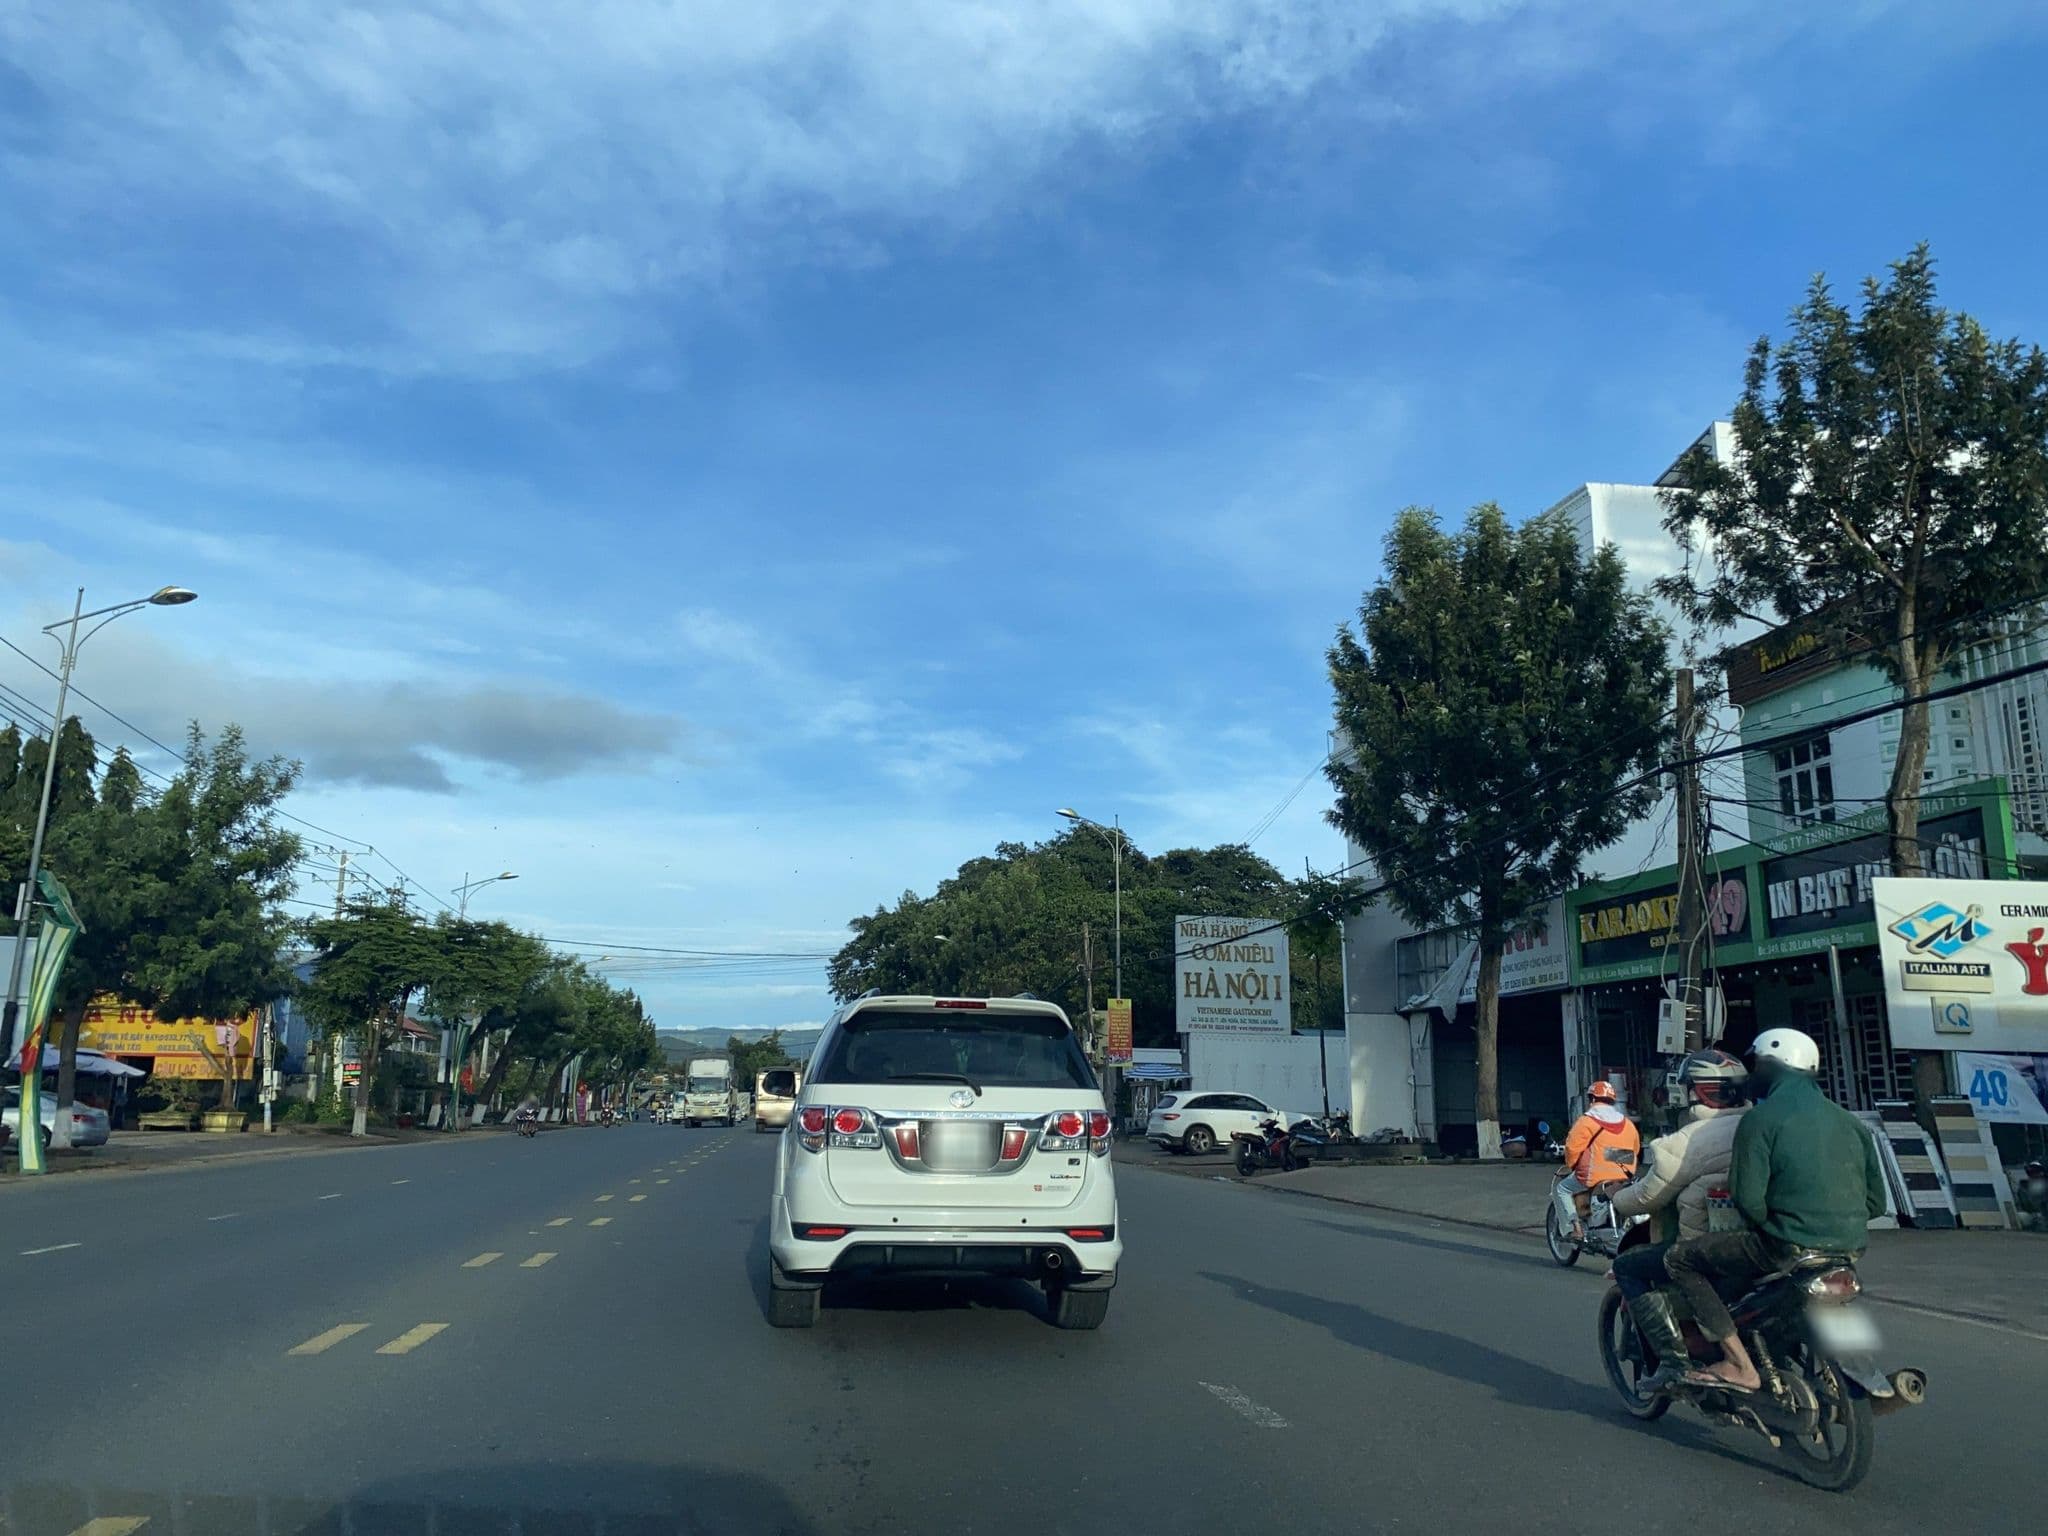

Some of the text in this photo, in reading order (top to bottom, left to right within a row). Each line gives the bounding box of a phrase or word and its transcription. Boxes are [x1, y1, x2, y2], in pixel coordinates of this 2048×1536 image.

[1789, 836, 1802, 850] TY
[1768, 880, 1797, 919] IN
[1798, 867, 1851, 918] BẠT
[1909, 963, 1986, 975] ITALIAN ART
[1184, 966, 1221, 998] HÀ
[1225, 967, 1269, 1005] NỘI
[1197, 1007, 1232, 1015] VIETNAMESE
[1970, 1070, 2007, 1106] 40
